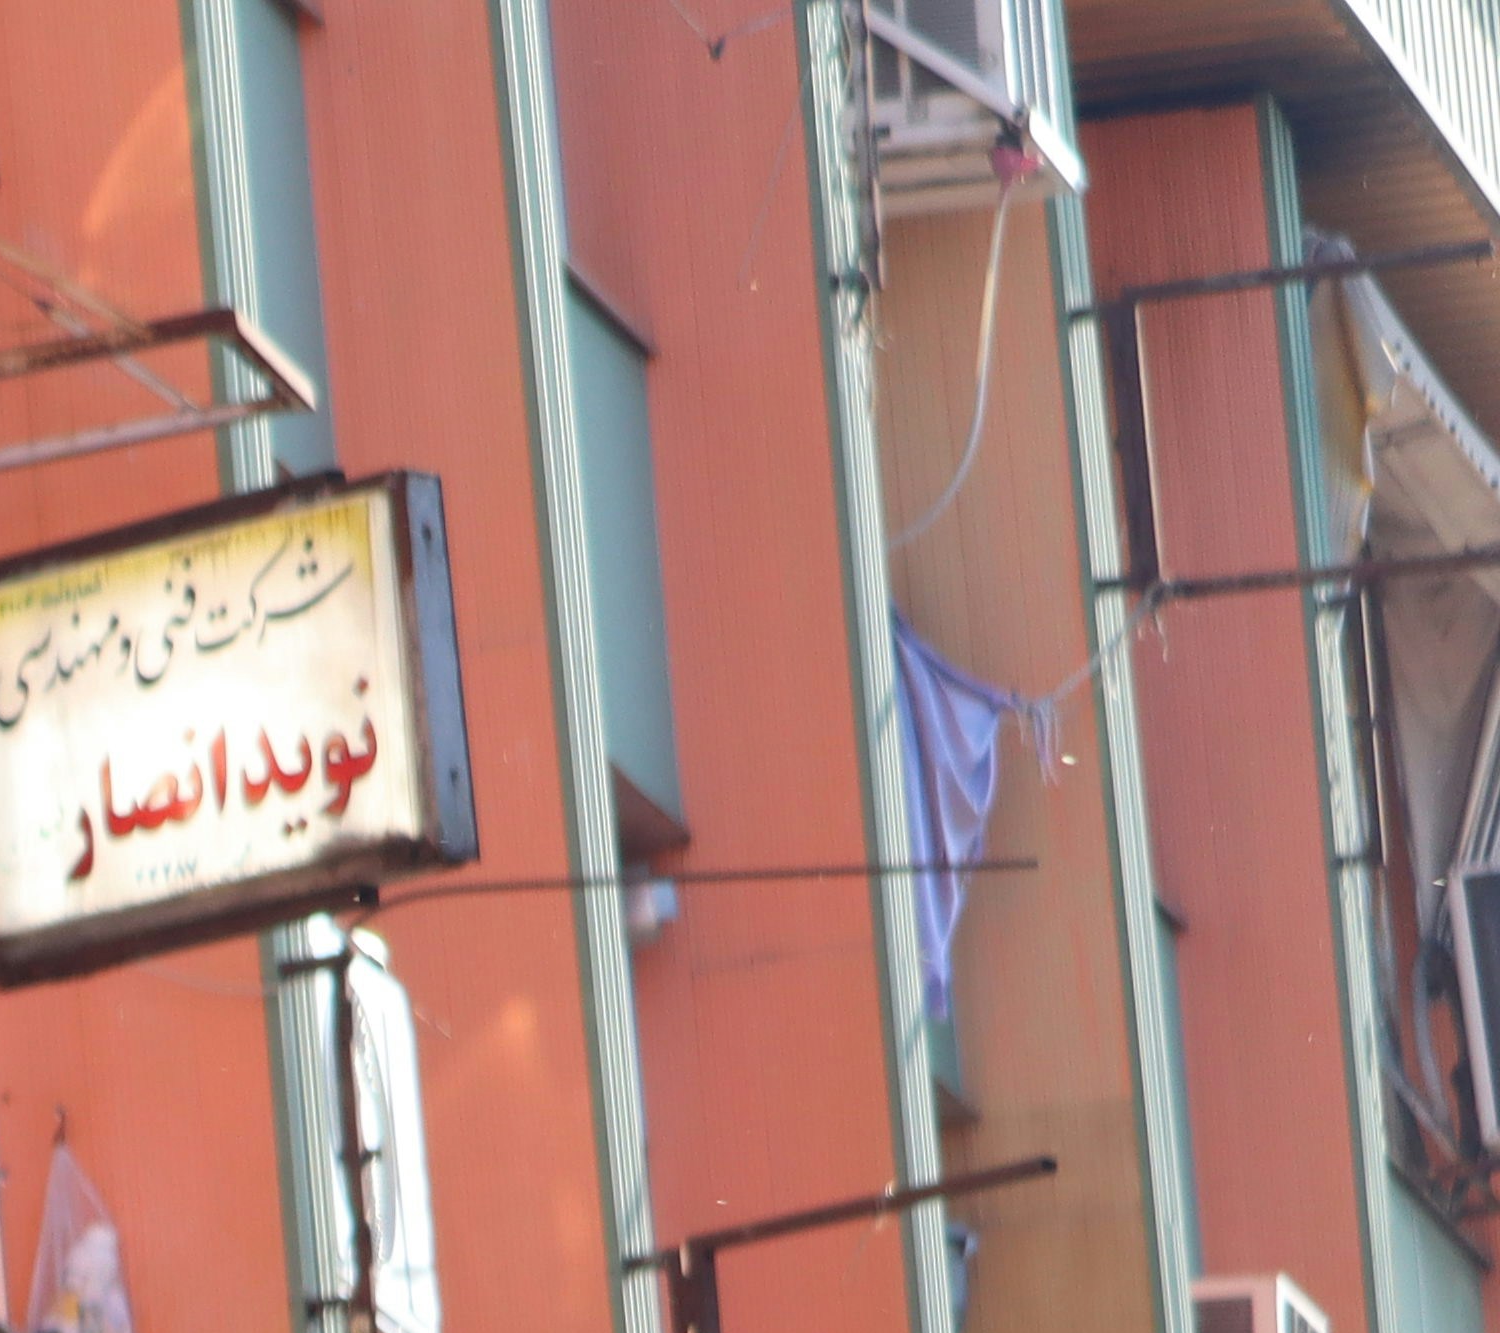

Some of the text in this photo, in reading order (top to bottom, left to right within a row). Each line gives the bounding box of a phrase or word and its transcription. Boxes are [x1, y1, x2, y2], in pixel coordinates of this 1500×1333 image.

[116, 627, 134, 676] و
[133, 555, 197, 687] فنی
[194, 529, 356, 651] شرکت
[67, 674, 378, 880] نوید انصار
